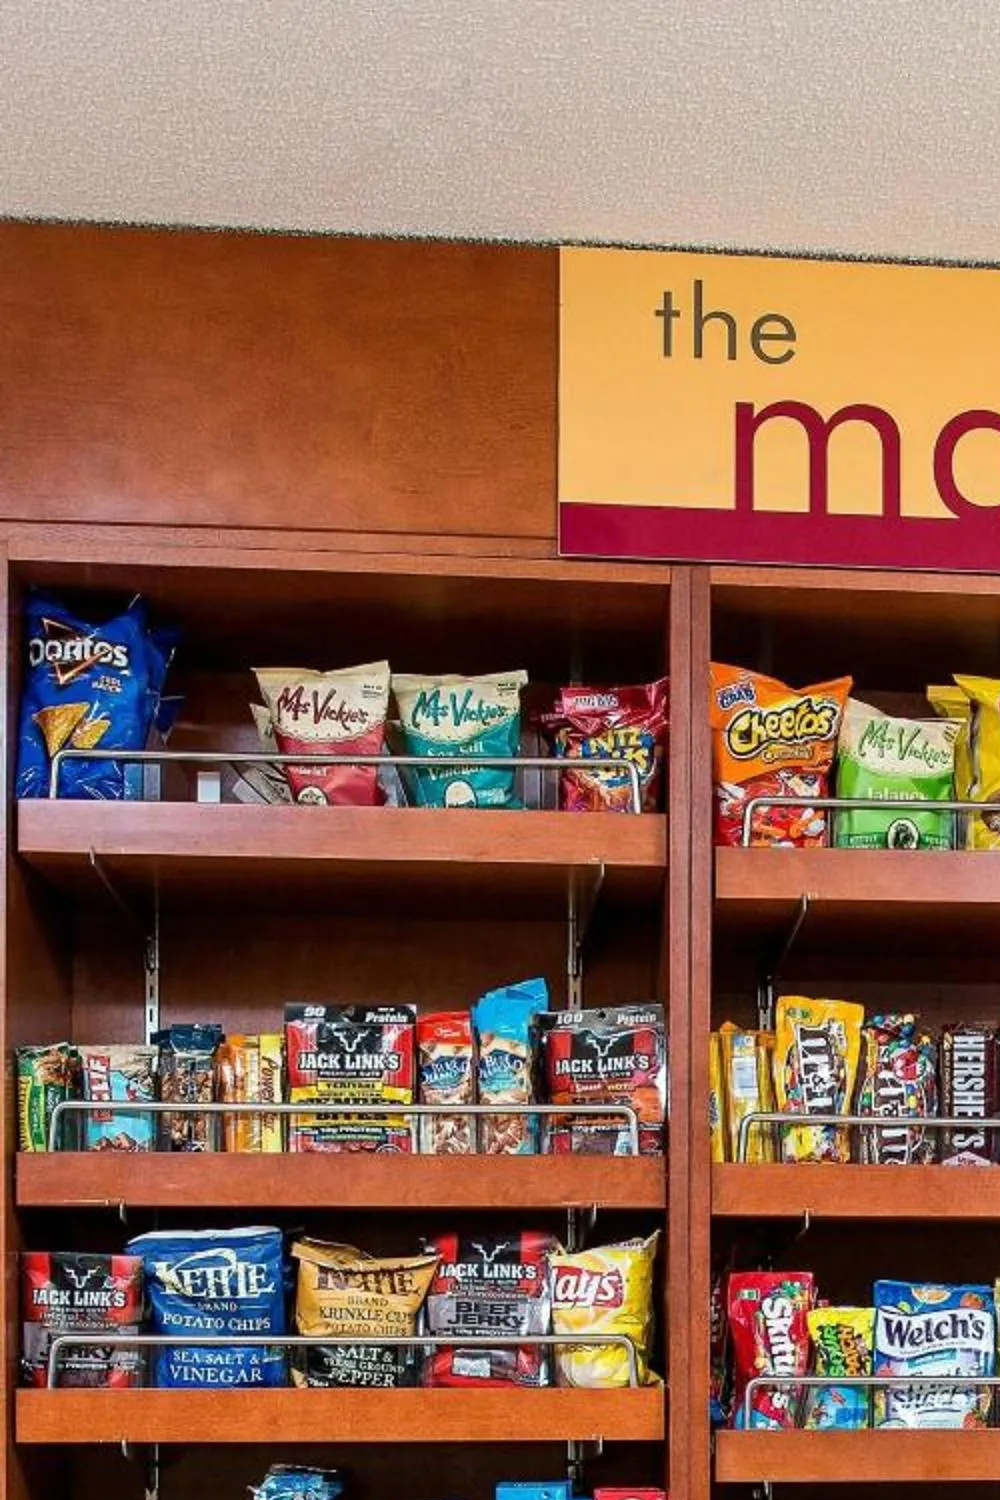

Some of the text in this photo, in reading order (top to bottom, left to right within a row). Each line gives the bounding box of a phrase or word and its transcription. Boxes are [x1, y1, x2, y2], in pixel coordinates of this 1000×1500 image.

[654, 279, 798, 365] the
[28, 637, 130, 669] Doritos
[727, 697, 838, 756] Cheetos
[299, 1053, 400, 1070] JACK LINK'S
[555, 1055, 650, 1075] JACK LINK'S
[952, 1034, 986, 1149] HERSHE'S
[440, 1263, 538, 1279] JACK LINK'S
[33, 1288, 126, 1307] JACK LINK'S
[319, 1306, 383, 1322] KRINKLE
[456, 1301, 519, 1315] BEEF
[162, 1313, 272, 1330] POTATO CHIPS
[447, 1314, 526, 1329] JERKY
[882, 1312, 985, 1349] Welch's
[173, 1350, 201, 1362] SEA
[203, 1352, 242, 1365] SALT
[336, 1346, 382, 1362] SALT
[761, 1297, 797, 1409] Skittls
[170, 1365, 265, 1383] VINEGAR
